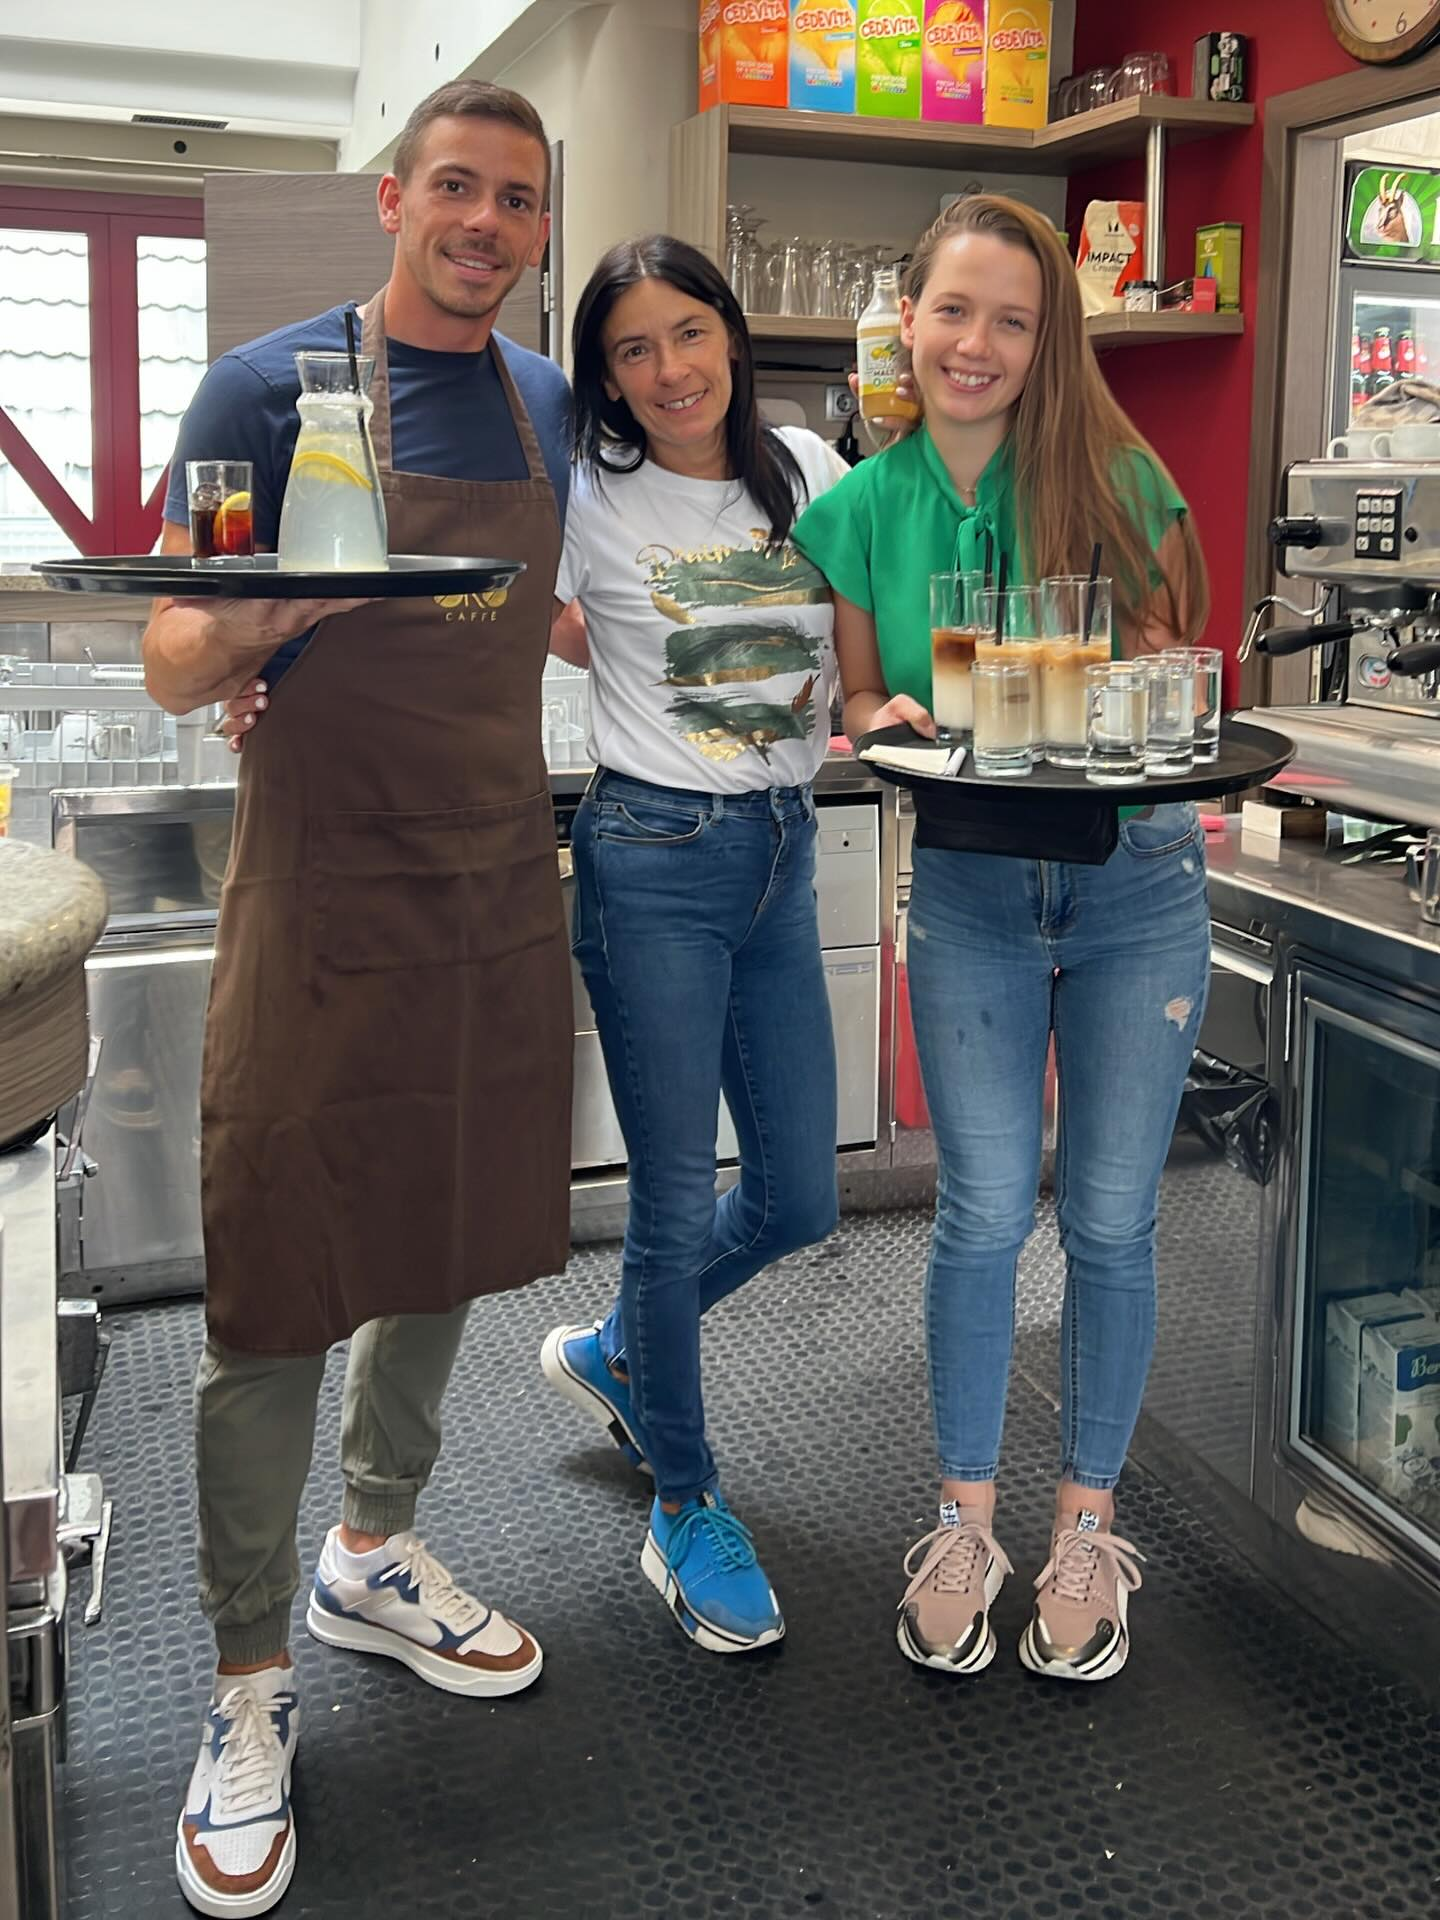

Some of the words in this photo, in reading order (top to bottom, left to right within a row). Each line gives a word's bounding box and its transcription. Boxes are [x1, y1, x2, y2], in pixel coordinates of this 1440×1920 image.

[723, 1, 786, 22] CEDEVITA
[795, 9, 852, 29] CEDEVITA
[861, 17, 918, 37] CEDEVITA
[1395, 11, 1408, 34] 6
[927, 25, 980, 43] CEDEVITA
[993, 30, 1045, 49] CEDEVITA
[1087, 251, 1133, 265] IMPACT
